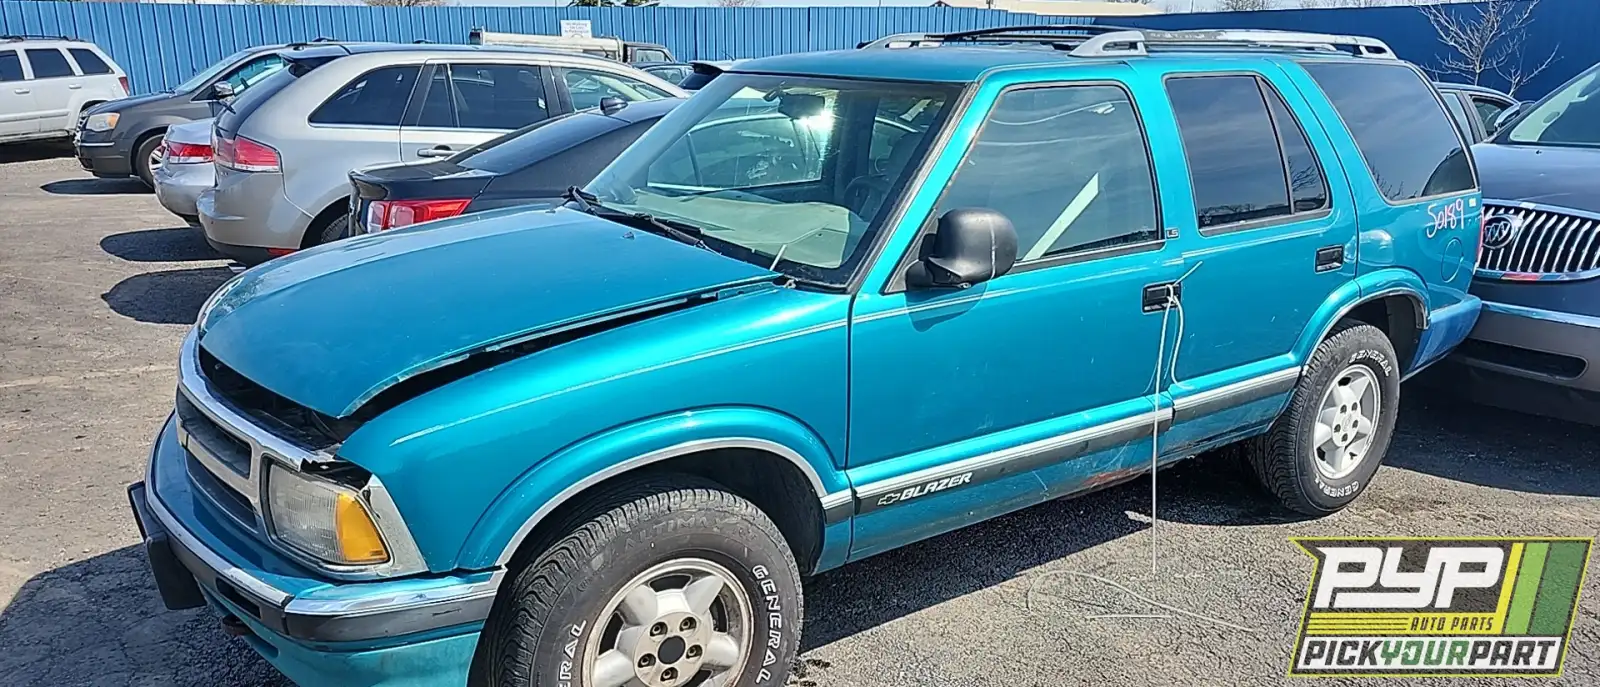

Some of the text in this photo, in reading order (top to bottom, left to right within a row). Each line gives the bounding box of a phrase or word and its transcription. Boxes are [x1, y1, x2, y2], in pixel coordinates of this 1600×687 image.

[1349, 350, 1393, 376] GENERAL
[900, 472, 973, 500] BLAZER
[1314, 473, 1359, 497] GENERAL
[753, 565, 782, 684] GENERAL
